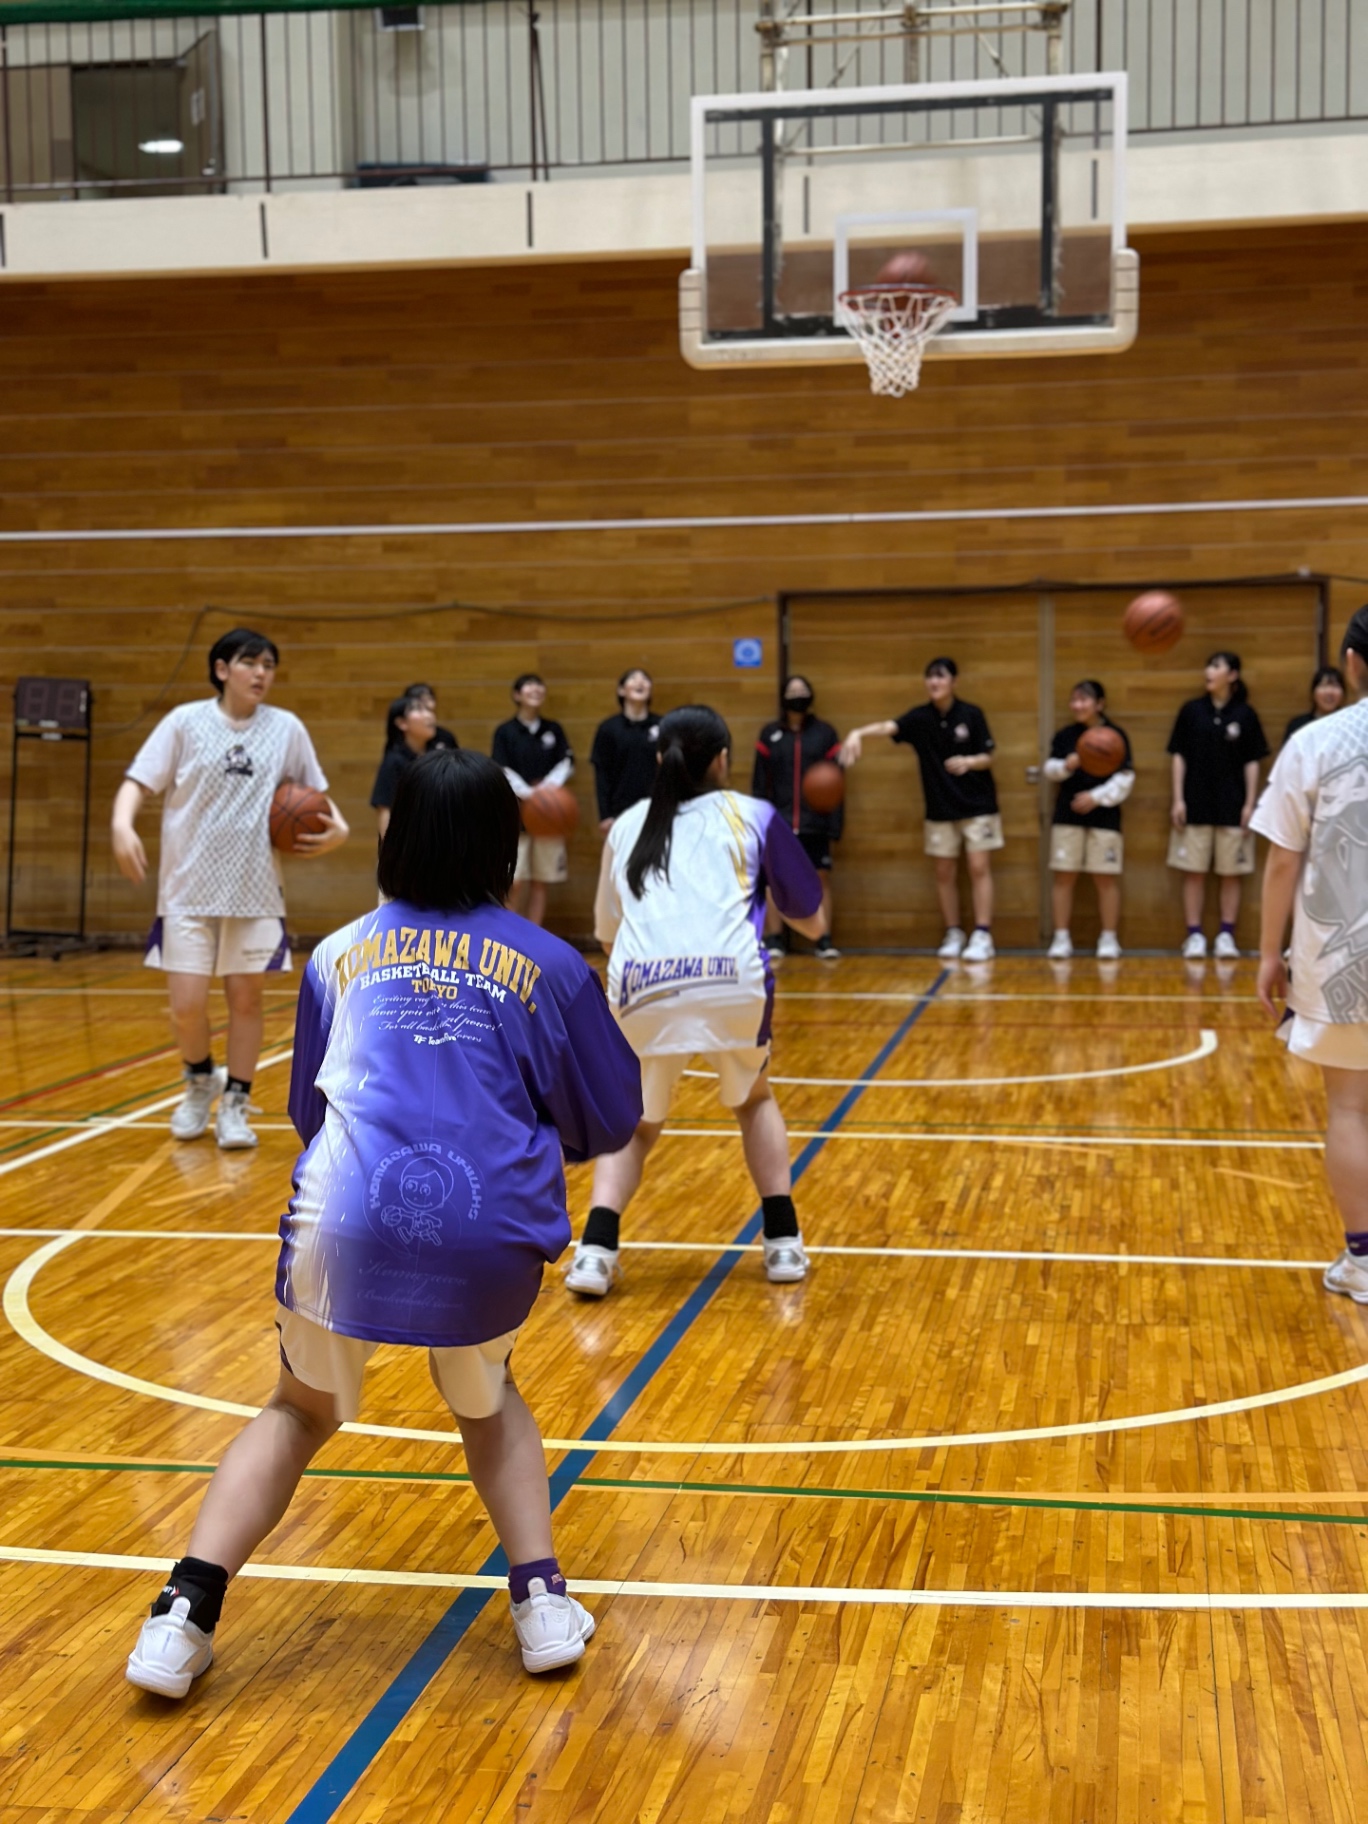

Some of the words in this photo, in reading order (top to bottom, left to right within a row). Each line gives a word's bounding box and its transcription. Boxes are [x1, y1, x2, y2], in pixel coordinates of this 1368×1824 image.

[334, 926, 471, 998] KOMAZAWA
[478, 937, 542, 1014] UNIV.
[360, 961, 460, 990] BASKETBALL
[465, 972, 508, 1003] TEAM
[412, 976, 458, 1000] TOKYO
[618, 956, 704, 1009] KOMAZAWA
[706, 955, 738, 977] UNIV.
[369, 1142, 442, 1210] KOMAZAWA
